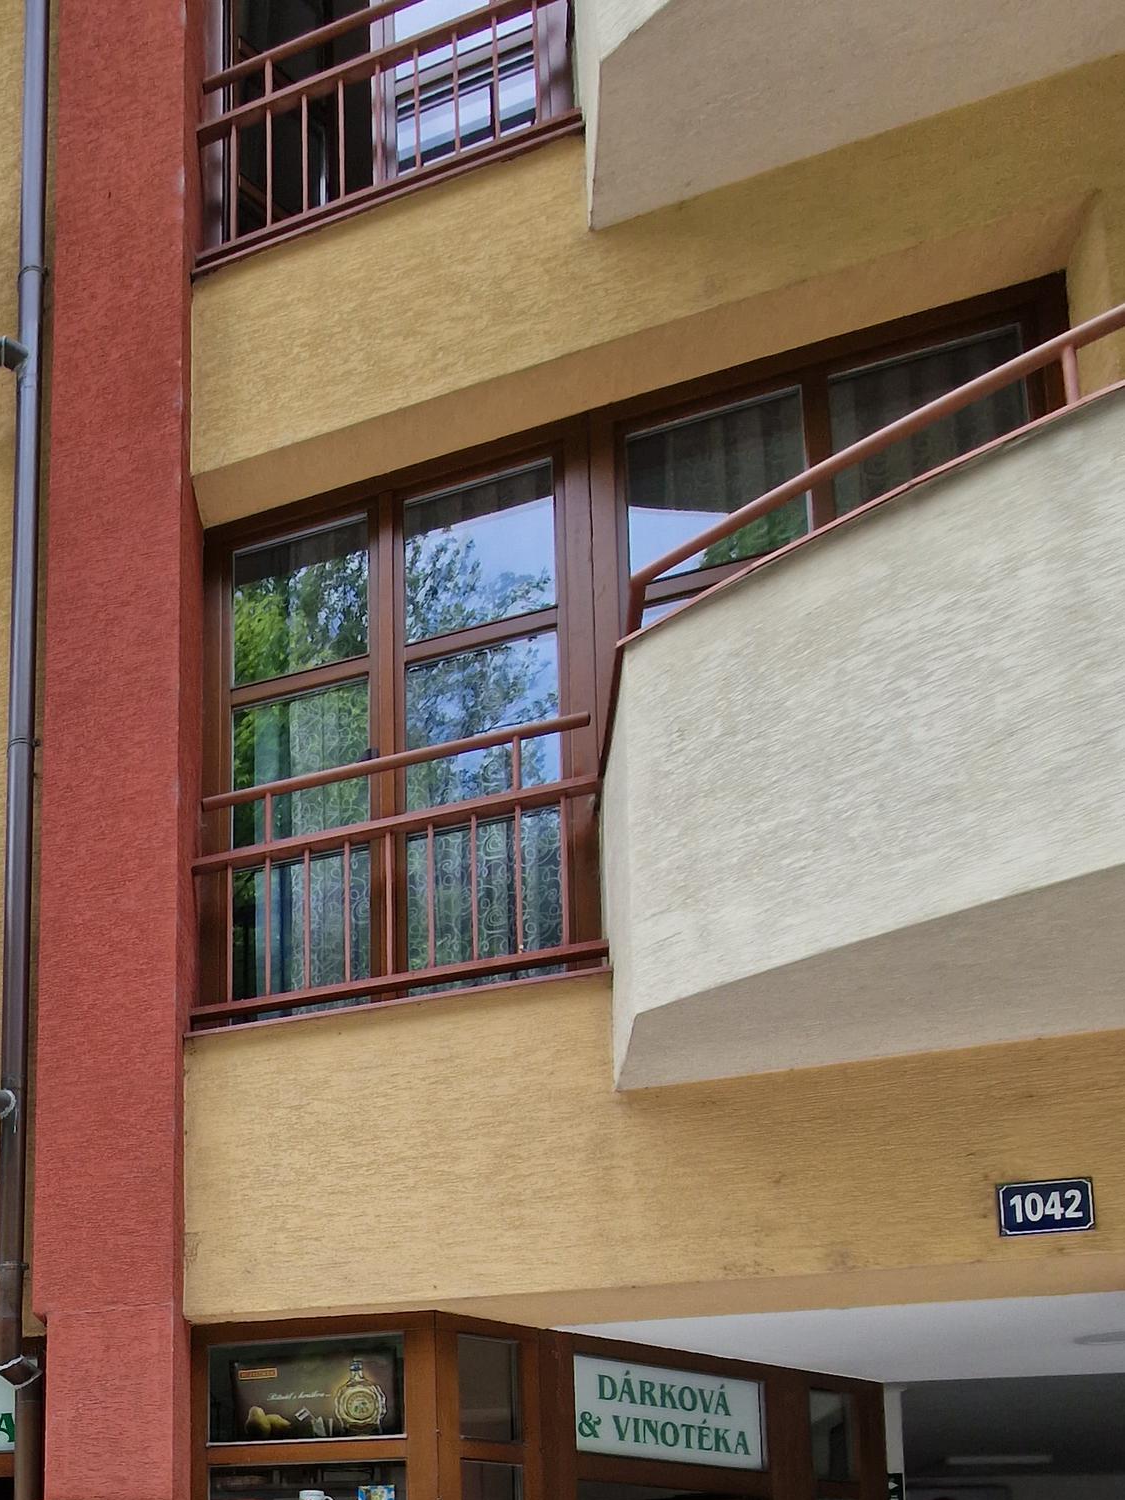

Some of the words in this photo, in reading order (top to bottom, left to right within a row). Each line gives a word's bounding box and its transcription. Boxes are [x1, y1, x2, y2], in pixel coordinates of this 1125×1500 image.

[1009, 1189, 1083, 1223] 1042
[597, 1370, 732, 1417] DÁRKOVÁ
[578, 1411, 602, 1438] &
[612, 1418, 752, 1455] VINOTÉKA
